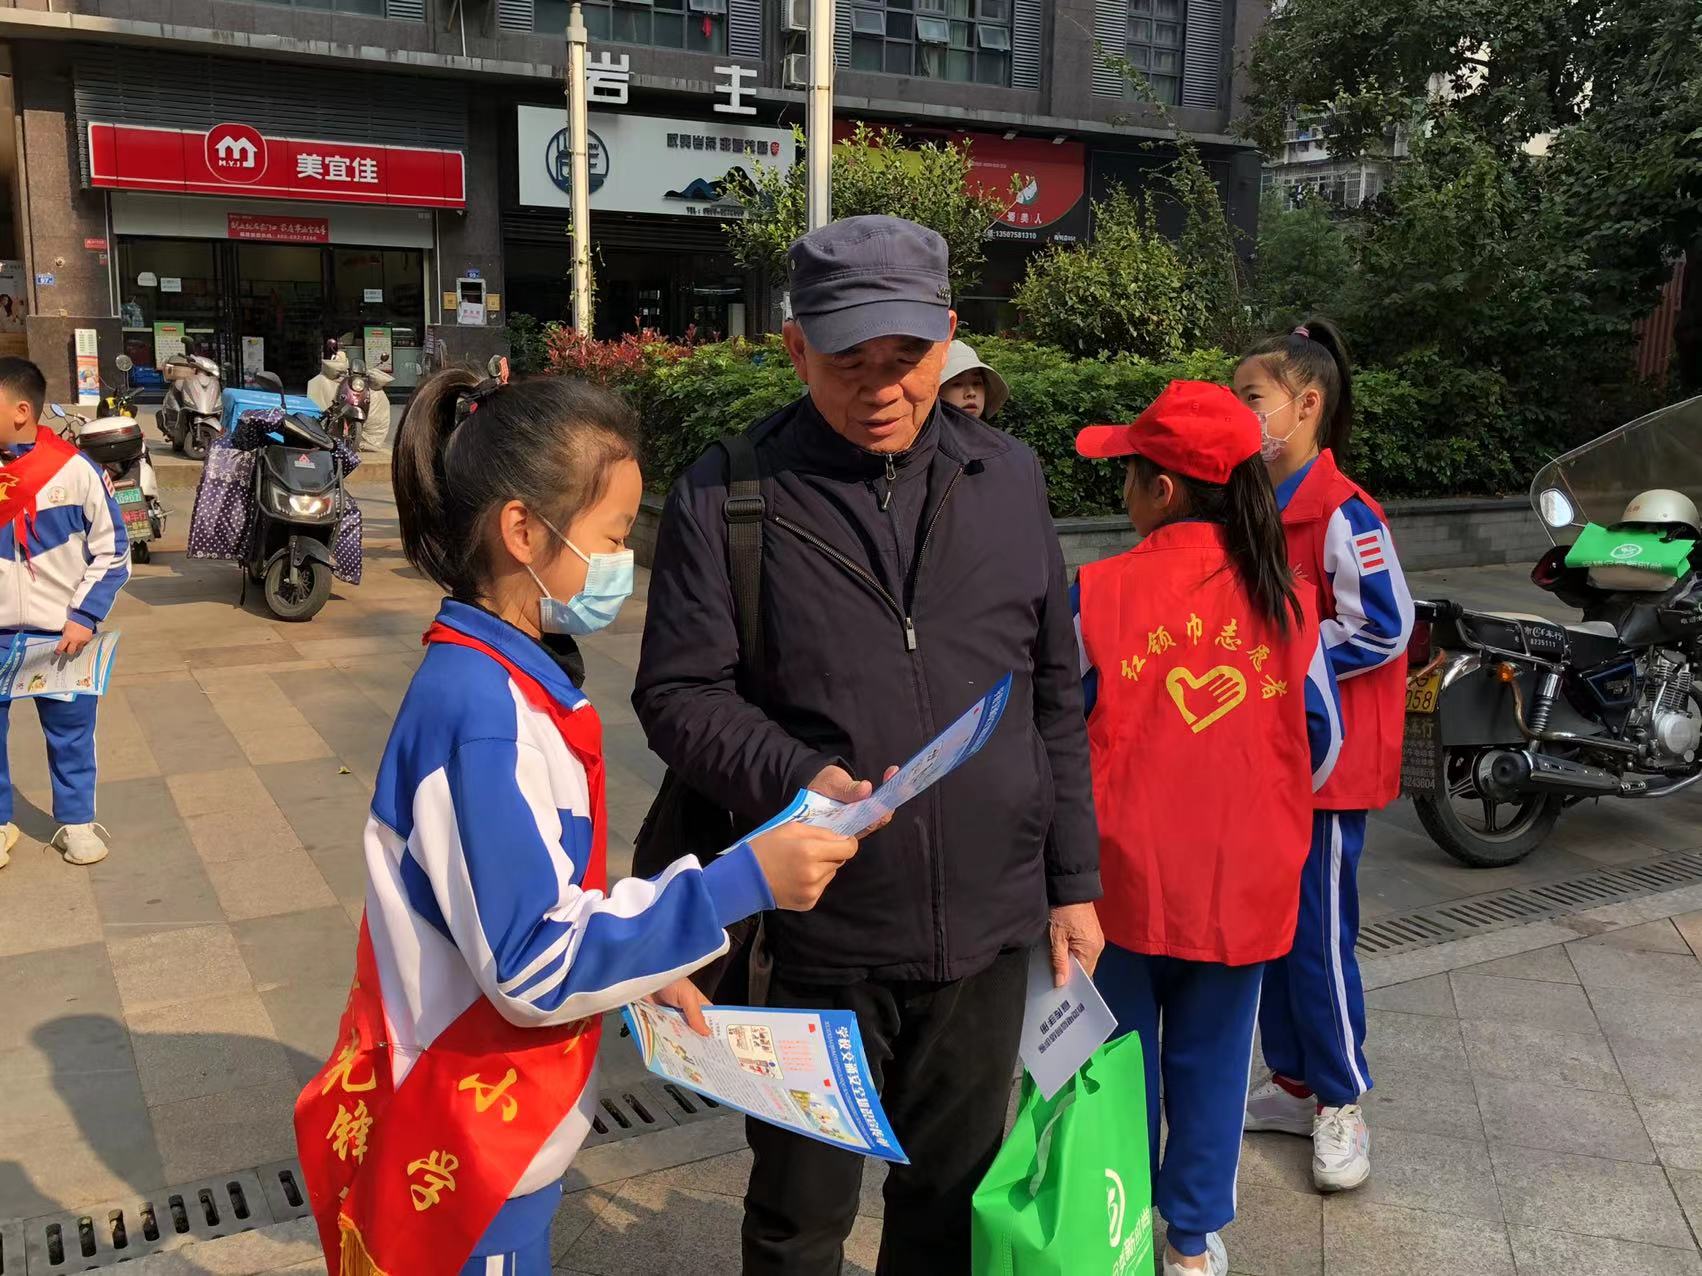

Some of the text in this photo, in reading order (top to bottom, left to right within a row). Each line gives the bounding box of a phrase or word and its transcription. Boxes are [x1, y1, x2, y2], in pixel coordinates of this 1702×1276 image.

[296, 153, 379, 183] 美宜佳
[1120, 613, 1288, 699] 红领巾志愿者
